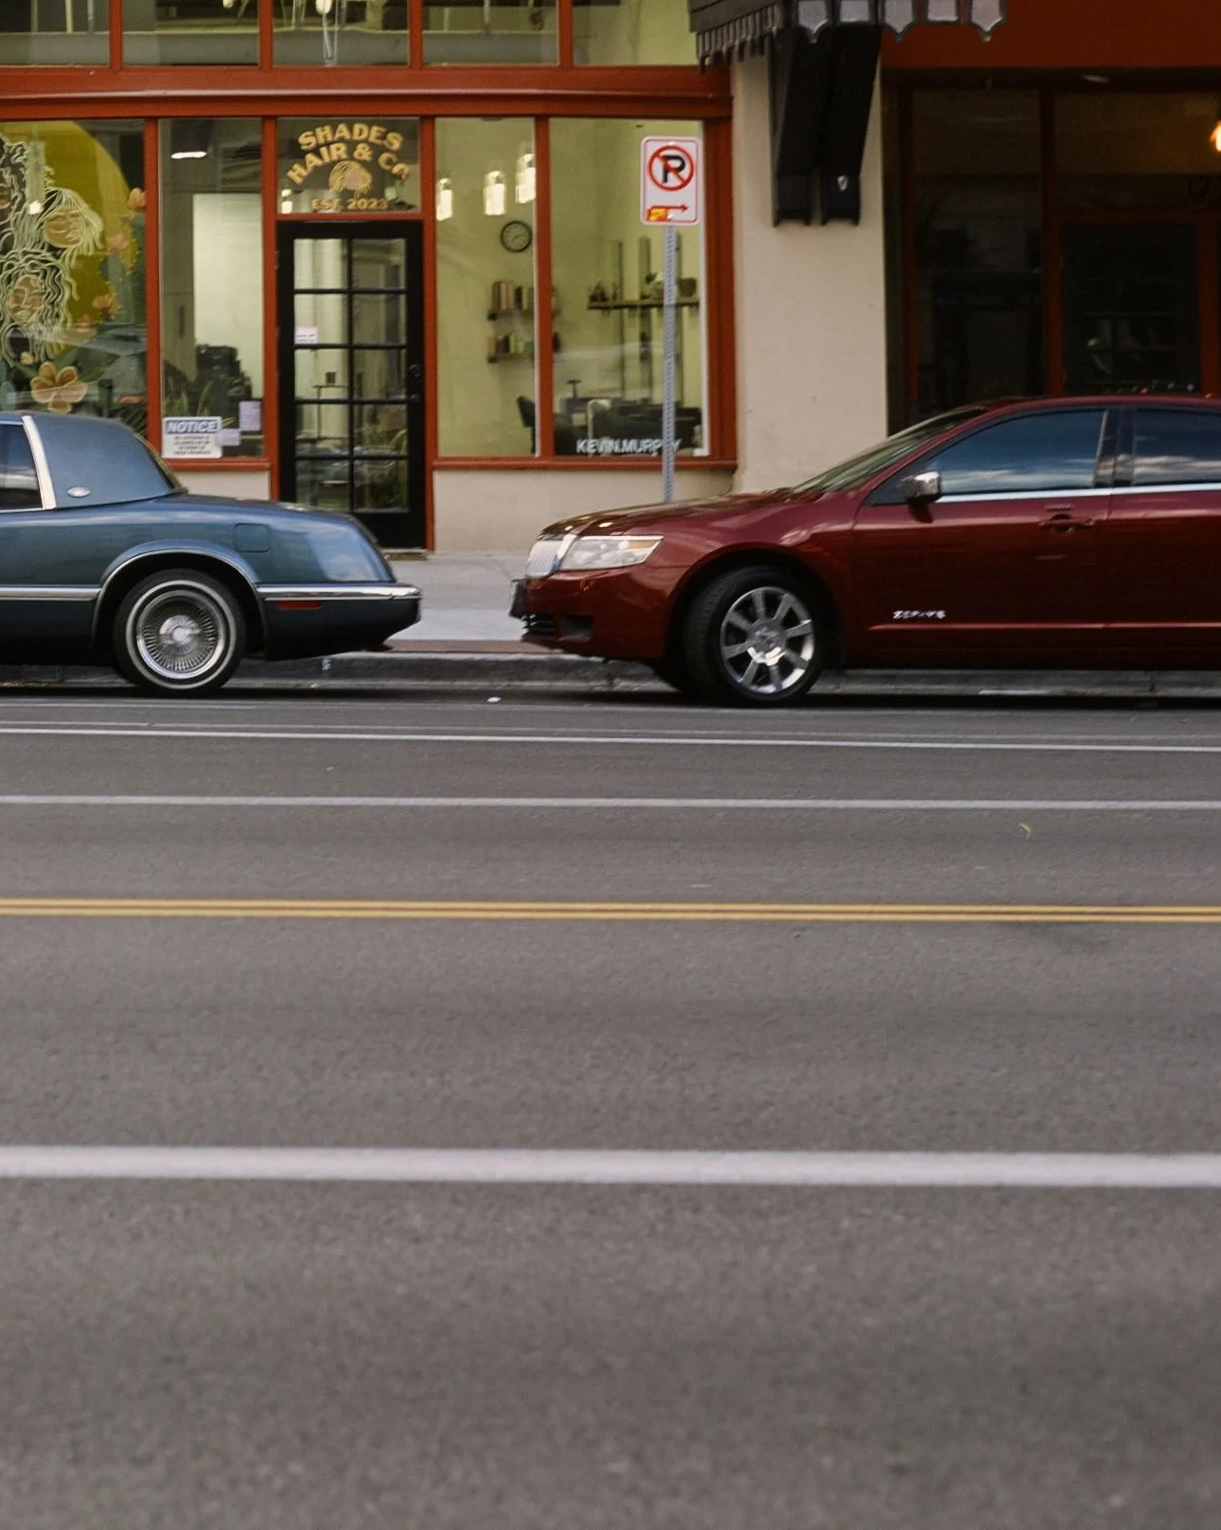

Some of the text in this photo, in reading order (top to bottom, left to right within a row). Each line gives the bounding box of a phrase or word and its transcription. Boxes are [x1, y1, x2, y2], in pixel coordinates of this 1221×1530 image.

[298, 123, 404, 151] SHADES
[286, 142, 348, 184] HAIR
[353, 142, 374, 161] &
[346, 198, 388, 211] 2023
[168, 420, 217, 433] NOTICE
[575, 437, 683, 455] KEVIN.MURPY
